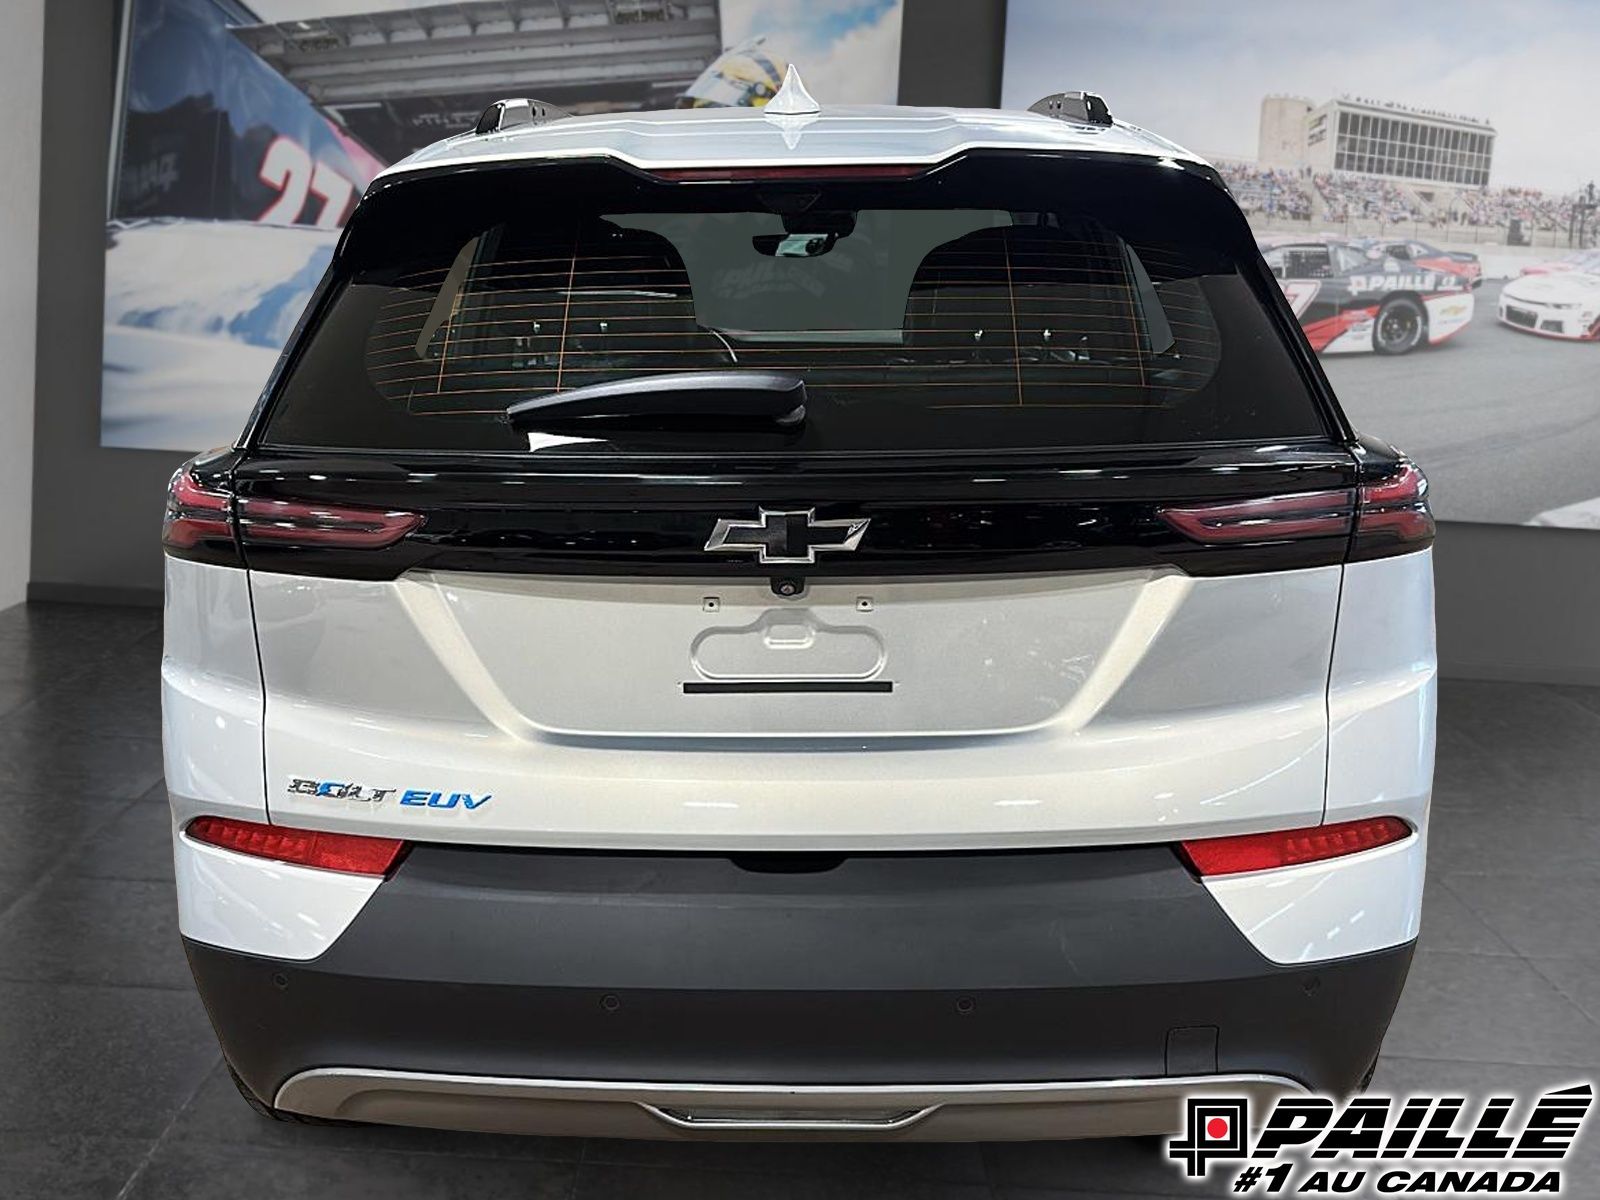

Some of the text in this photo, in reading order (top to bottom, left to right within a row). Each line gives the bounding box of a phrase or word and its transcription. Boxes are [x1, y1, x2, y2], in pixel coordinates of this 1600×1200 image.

[259, 134, 354, 229] 27
[286, 778, 492, 810] BOLT EUV
